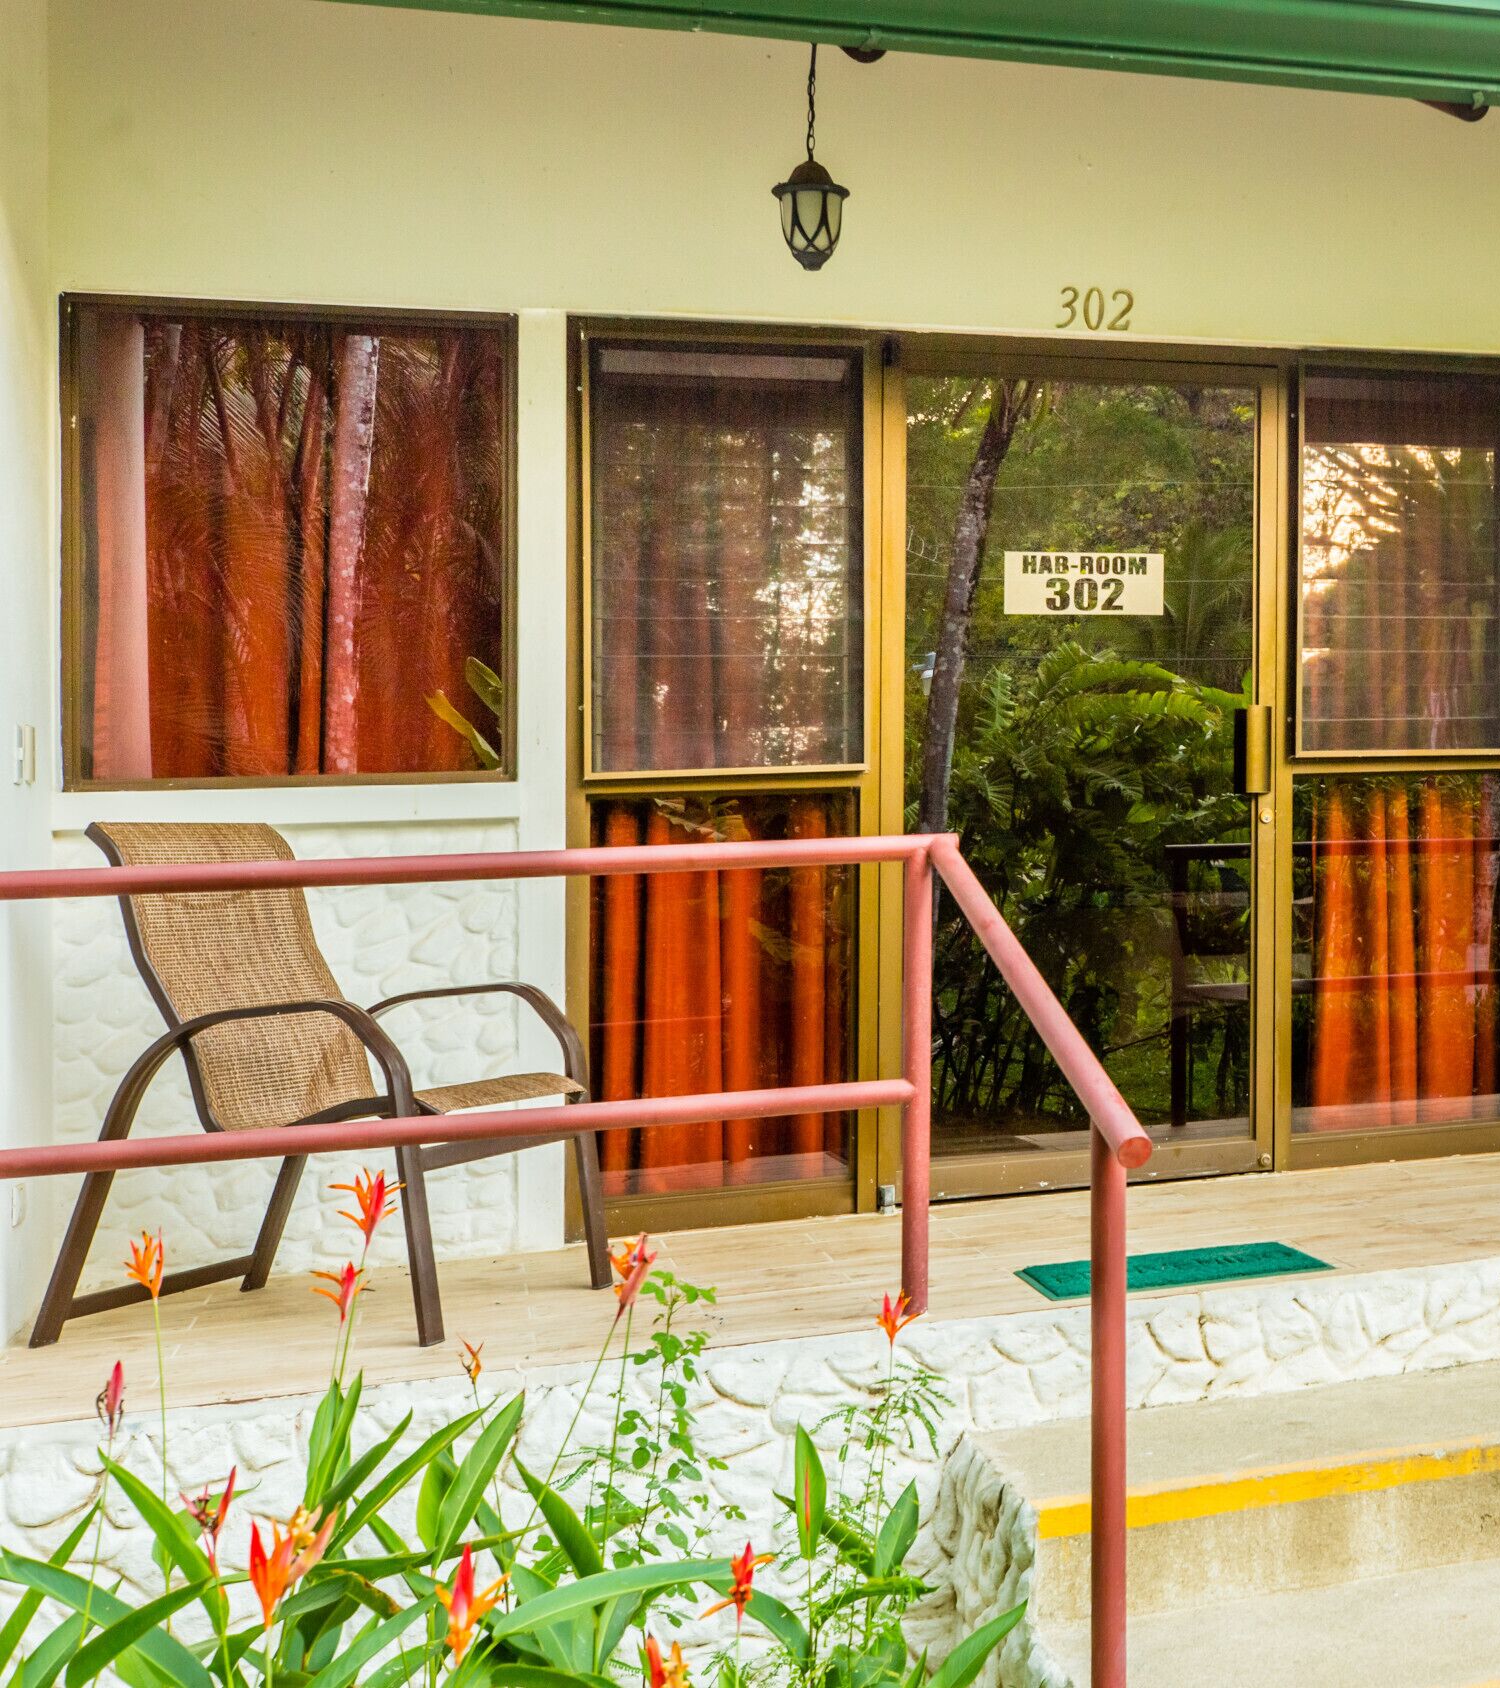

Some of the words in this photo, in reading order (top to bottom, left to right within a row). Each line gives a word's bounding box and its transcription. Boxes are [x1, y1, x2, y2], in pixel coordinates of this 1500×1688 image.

[1056, 286, 1134, 331] 302
[1022, 554, 1147, 575] HAB-ROOM
[1045, 577, 1125, 611] 302
